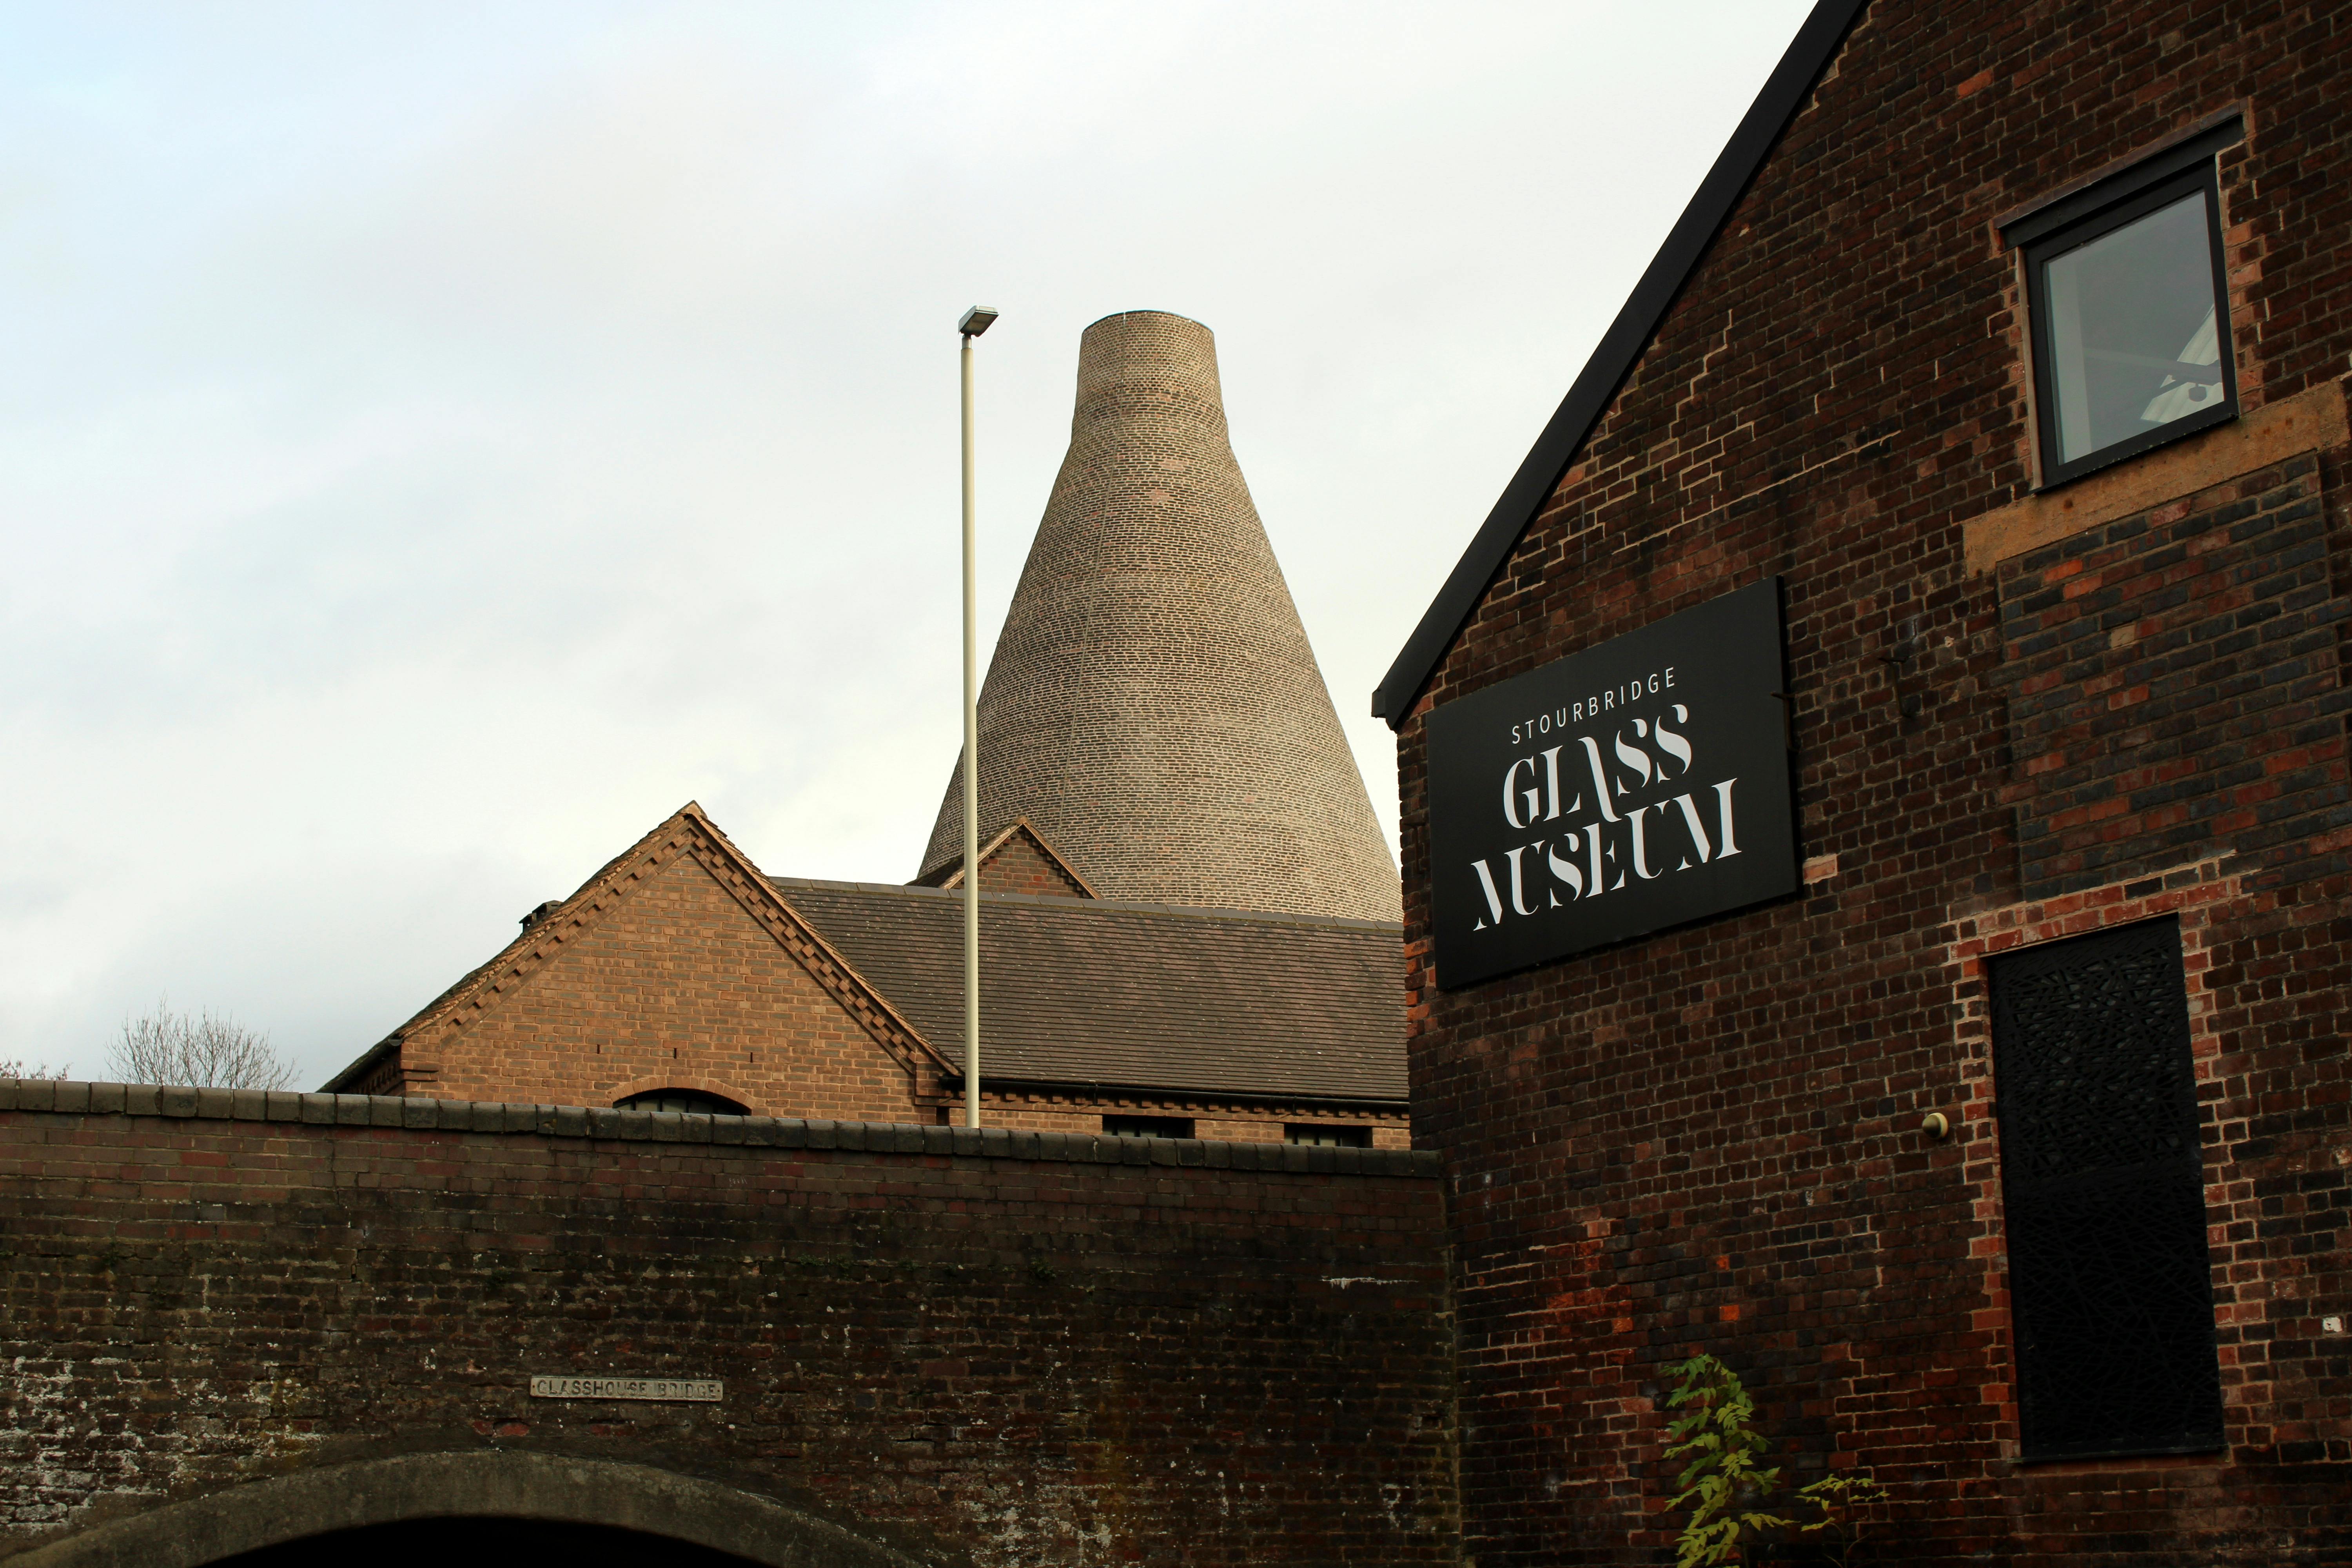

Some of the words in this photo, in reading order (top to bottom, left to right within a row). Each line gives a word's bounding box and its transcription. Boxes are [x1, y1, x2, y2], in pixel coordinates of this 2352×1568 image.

[1512, 667, 1675, 744] STOURBRIDGE
[1503, 704, 1691, 829] GLASS
[1471, 778, 1742, 931] MUSEUM
[537, 1379, 648, 1397] GLASSHOUSE
[657, 1382, 716, 1398] BRIDGE
